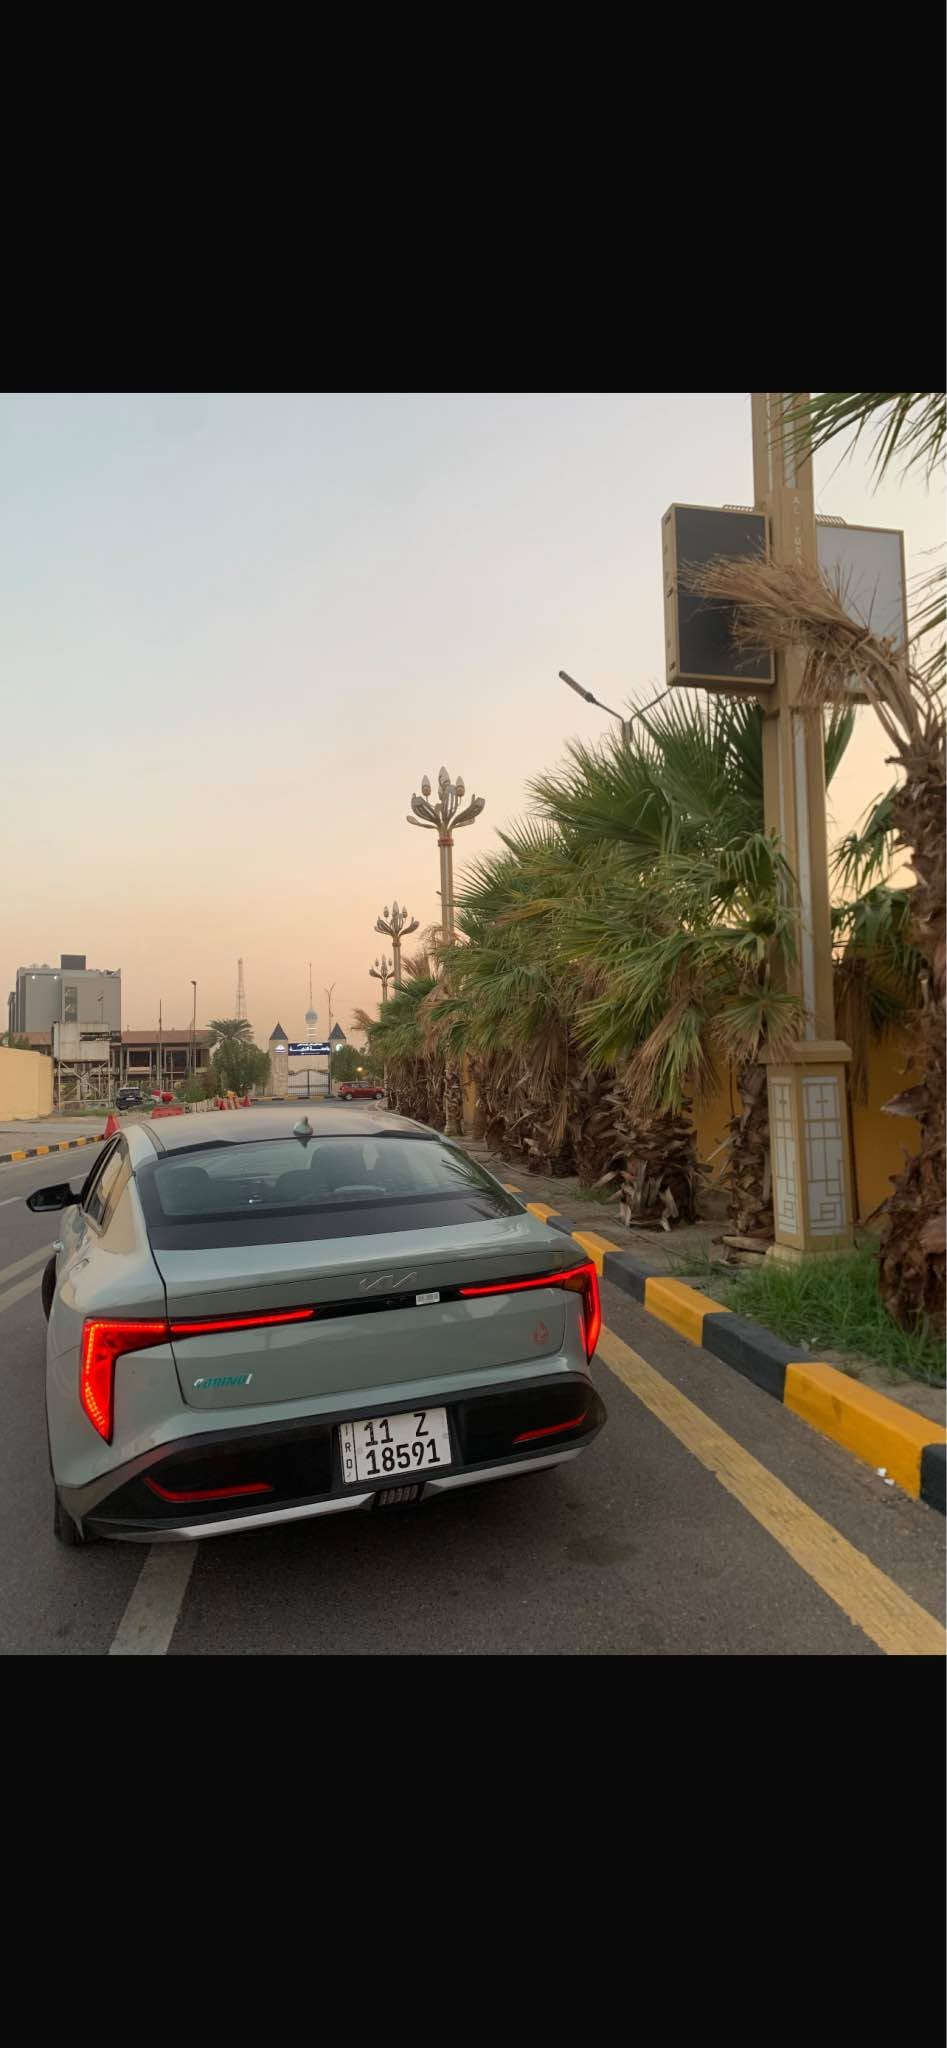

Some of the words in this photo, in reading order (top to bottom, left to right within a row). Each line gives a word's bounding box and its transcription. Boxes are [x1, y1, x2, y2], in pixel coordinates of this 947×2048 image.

[364, 1419, 393, 1446] 11
[414, 1412, 429, 1437] Z
[366, 1438, 440, 1475] 18591
